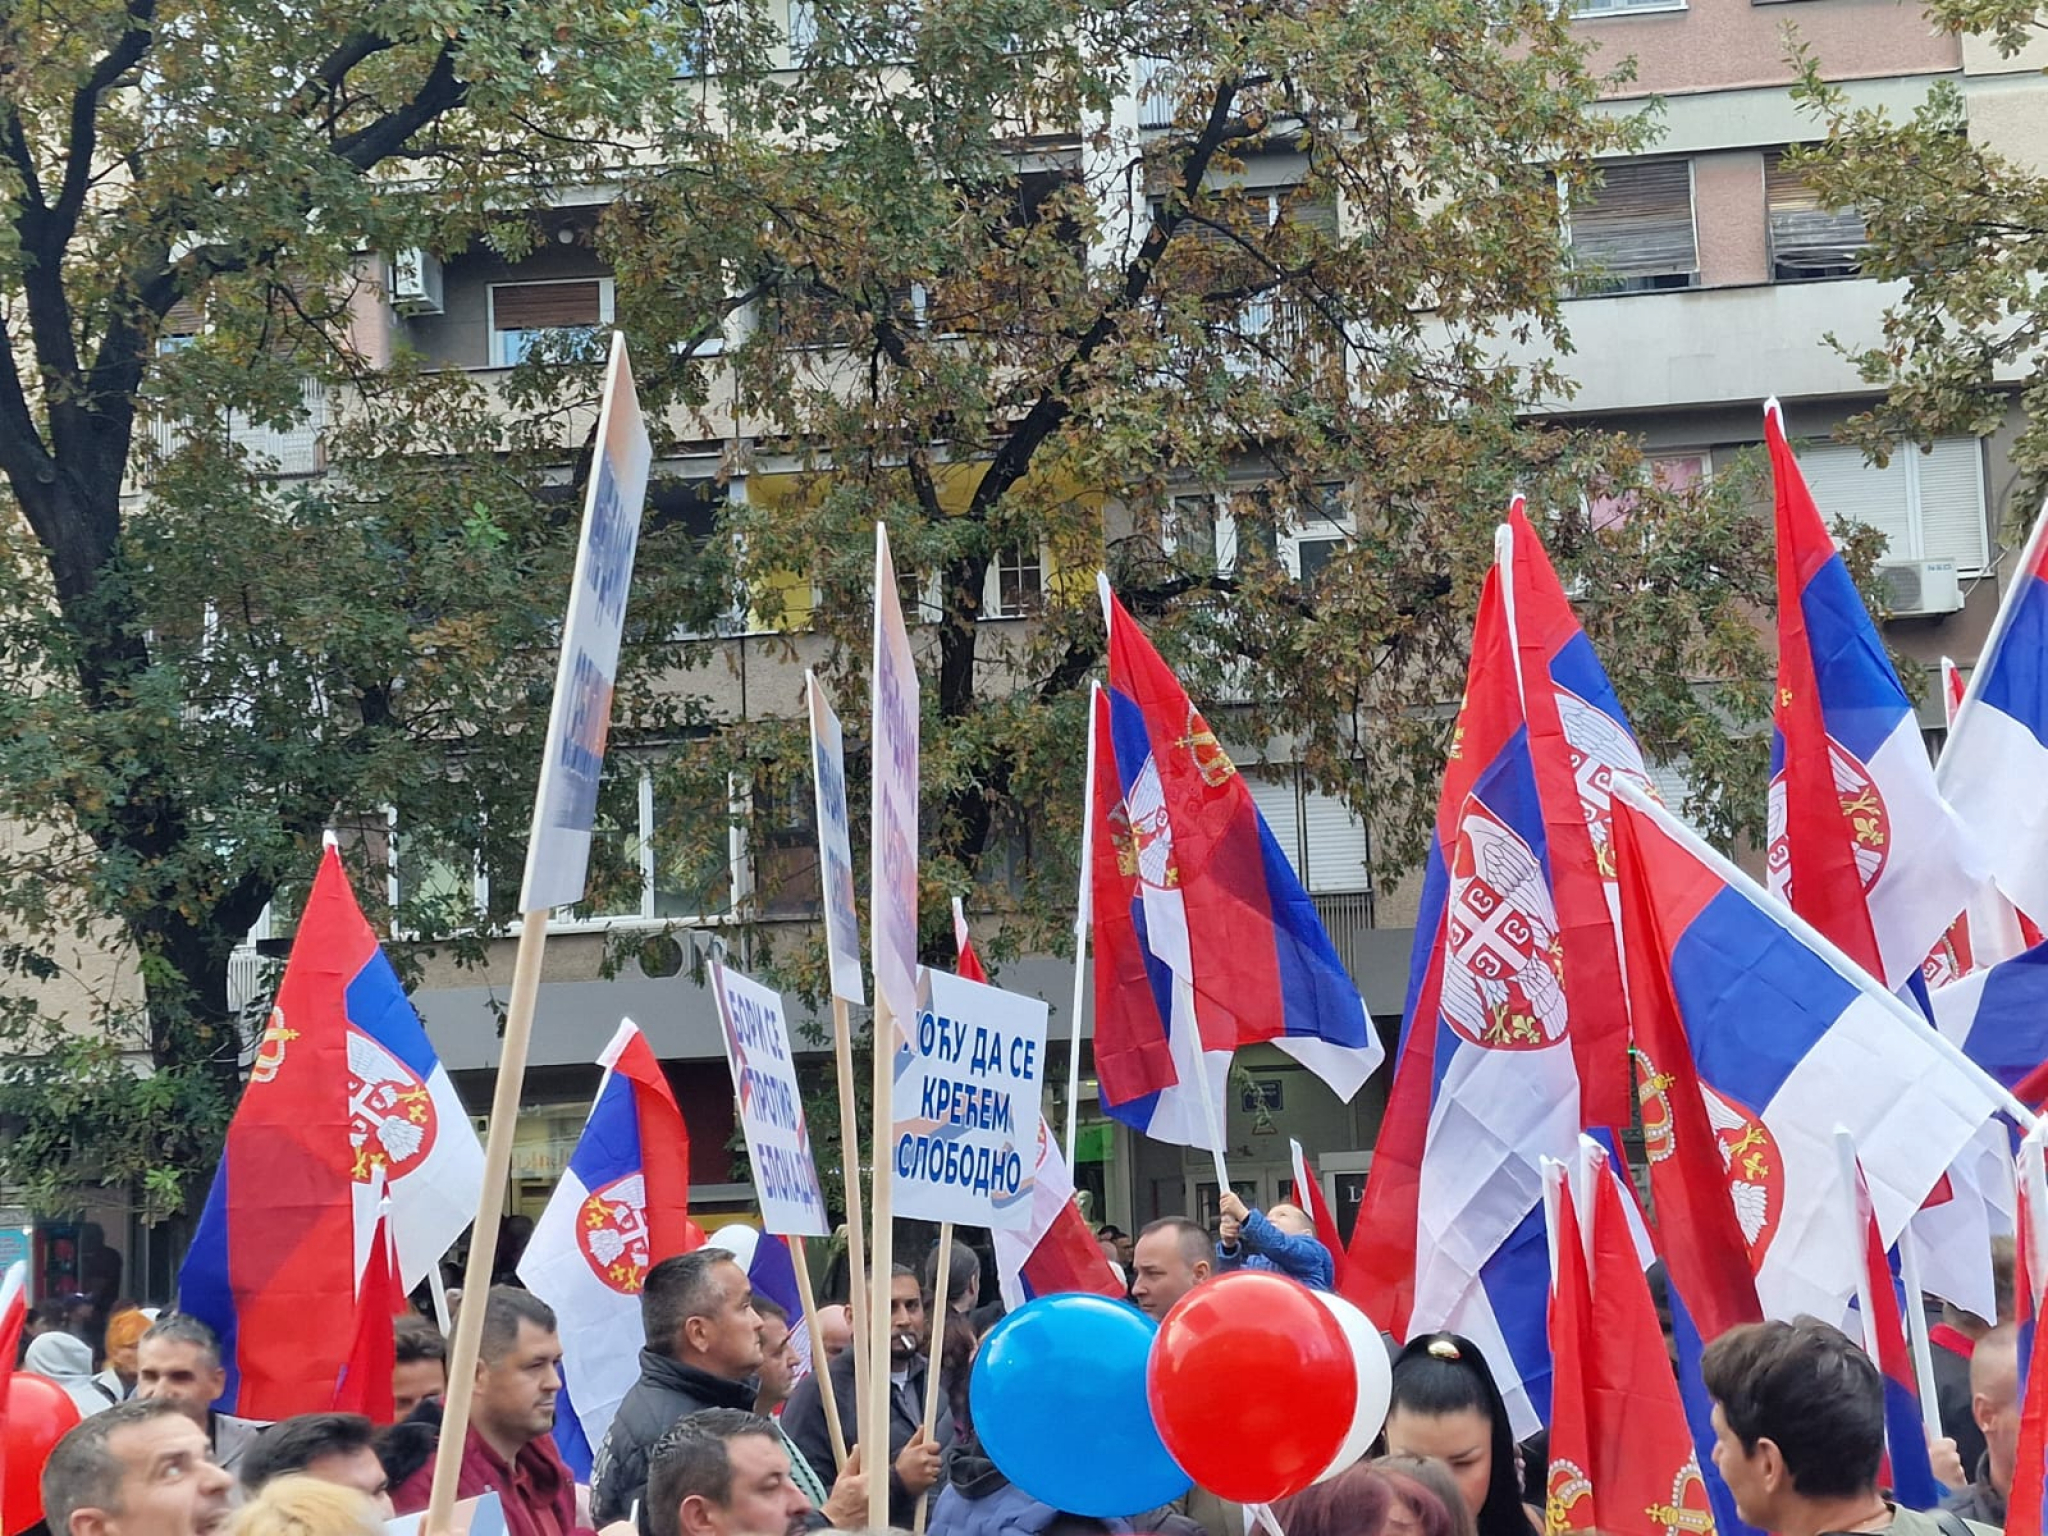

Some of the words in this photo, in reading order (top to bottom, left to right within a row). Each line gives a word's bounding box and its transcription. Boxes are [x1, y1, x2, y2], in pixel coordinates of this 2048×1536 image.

[727, 989, 768, 1056] БОРИ
[763, 1006, 785, 1061] СЕ
[904, 1010, 968, 1063] ОЋУ
[970, 1027, 1002, 1077] ДА
[1010, 1036, 1036, 1080] СЕ
[745, 1067, 797, 1131] ПРОТИВ
[920, 1075, 1011, 1133] КРЕЋЕМ
[898, 1133, 1021, 1198] СЛОБОДНО
